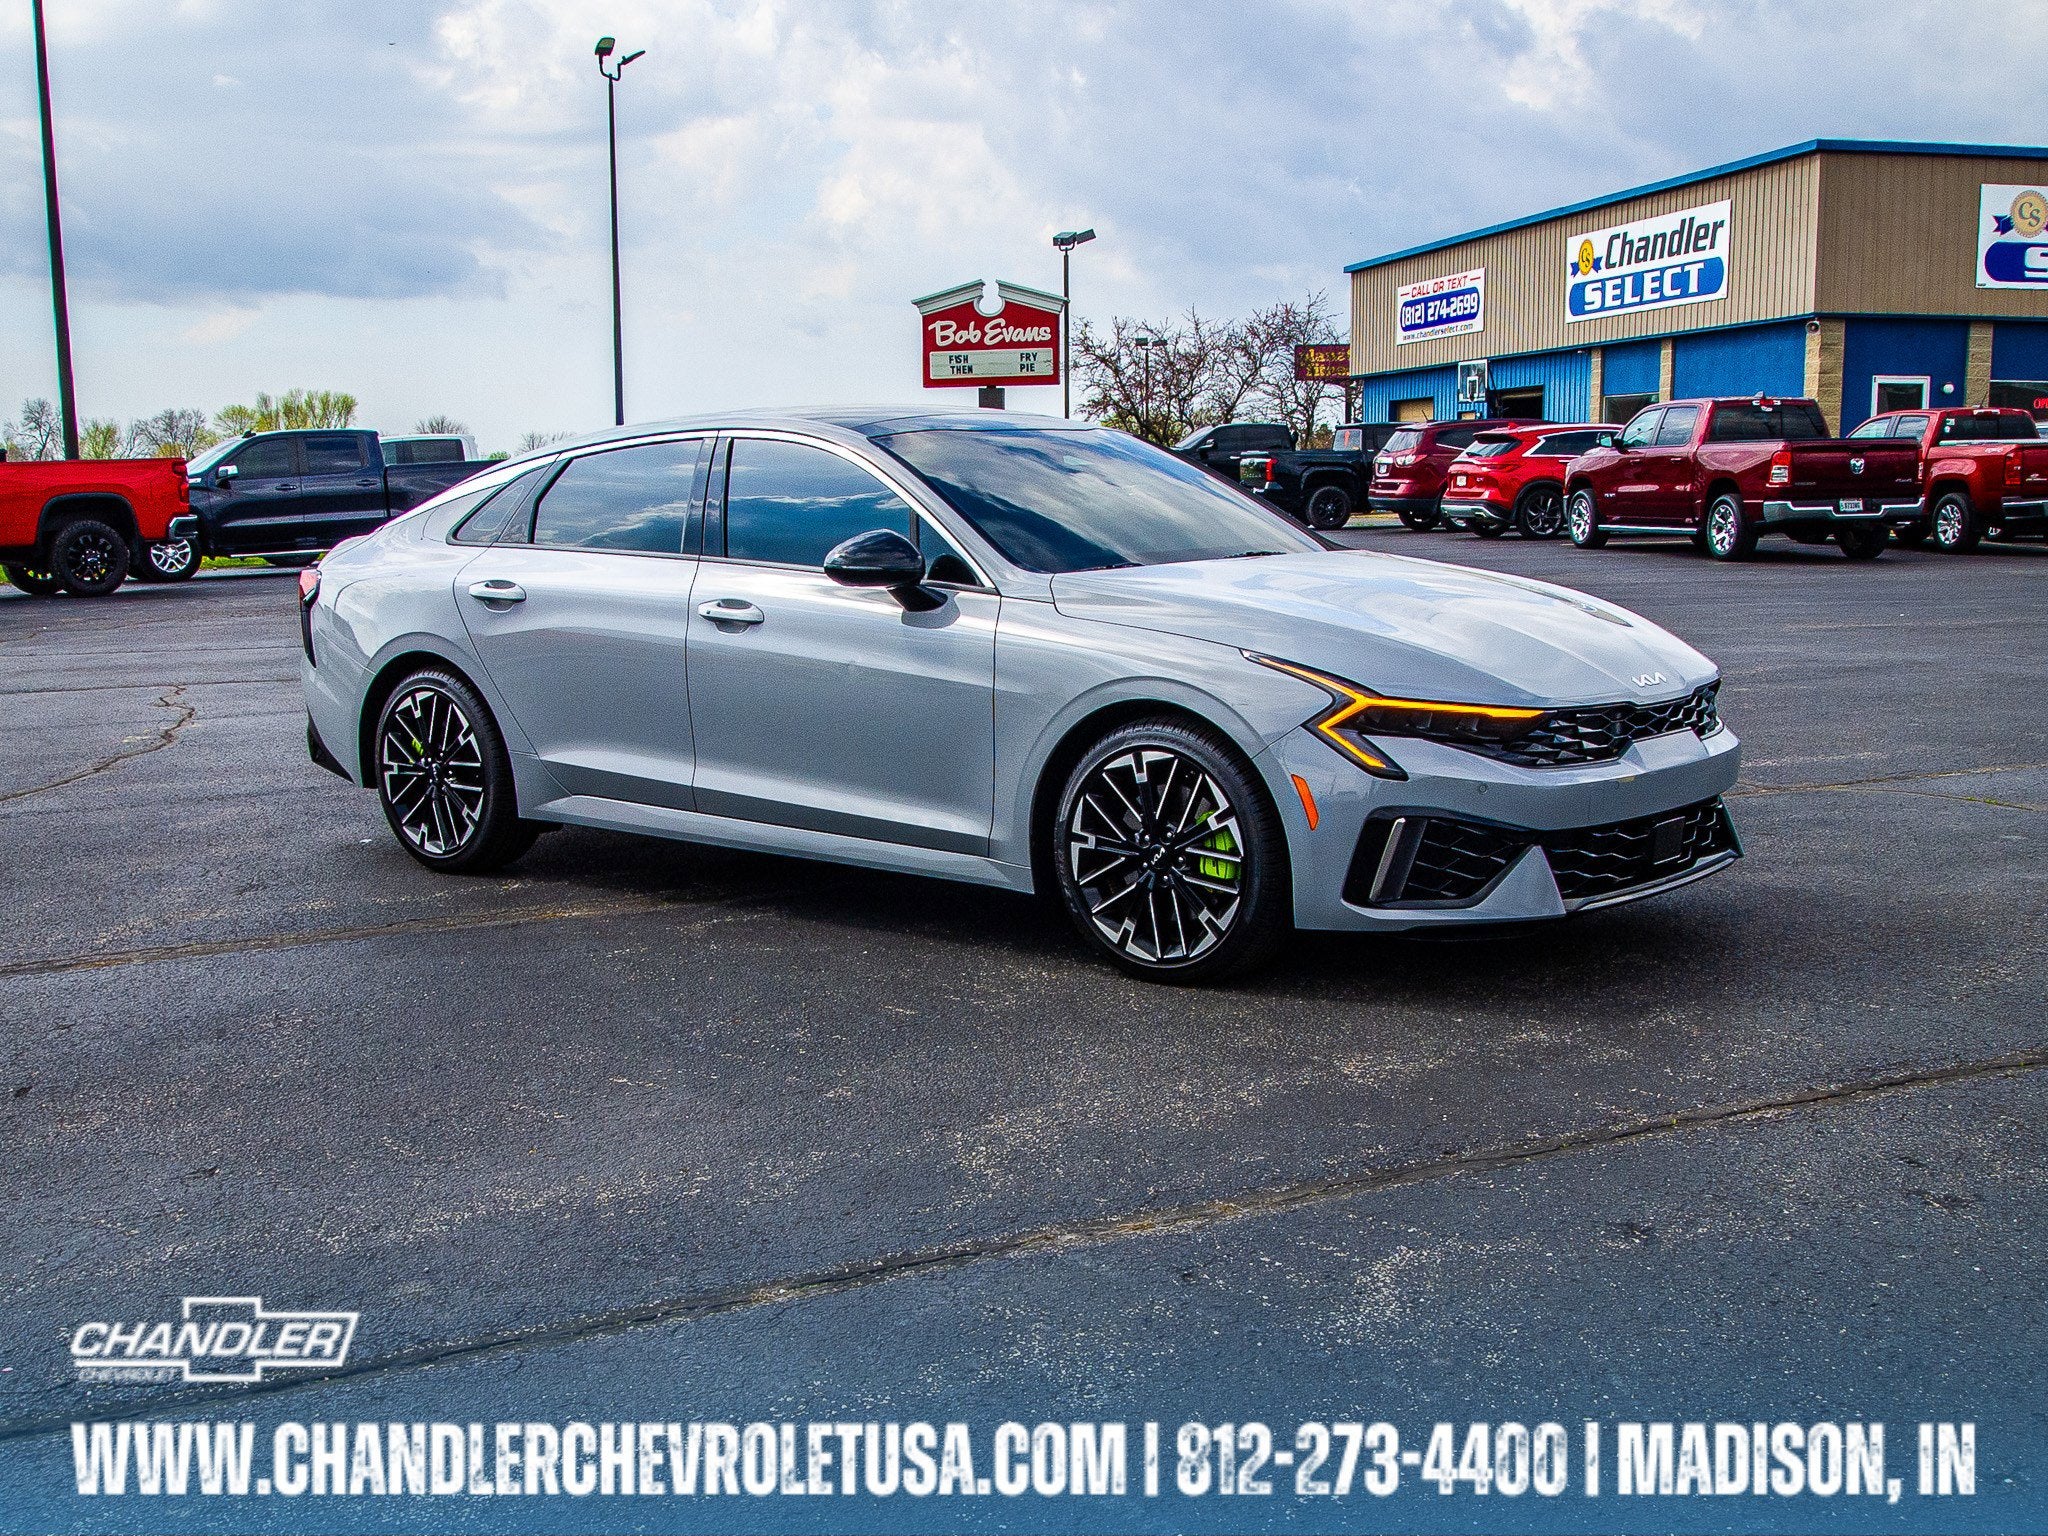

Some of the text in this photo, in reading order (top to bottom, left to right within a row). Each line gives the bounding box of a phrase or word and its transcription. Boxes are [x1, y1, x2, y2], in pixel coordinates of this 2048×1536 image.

[1605, 216, 1726, 270] Chandler
[1411, 275, 1468, 298] CALL OR TEXT
[1584, 262, 1706, 311] SELECT
[1401, 292, 1479, 328] (812) 274-2699
[928, 318, 1051, 346] Bob Evans
[1402, 322, 1474, 341] www.chandlerselect.com
[949, 352, 1038, 364] FISH FRY
[950, 362, 1036, 374] THEN PIE
